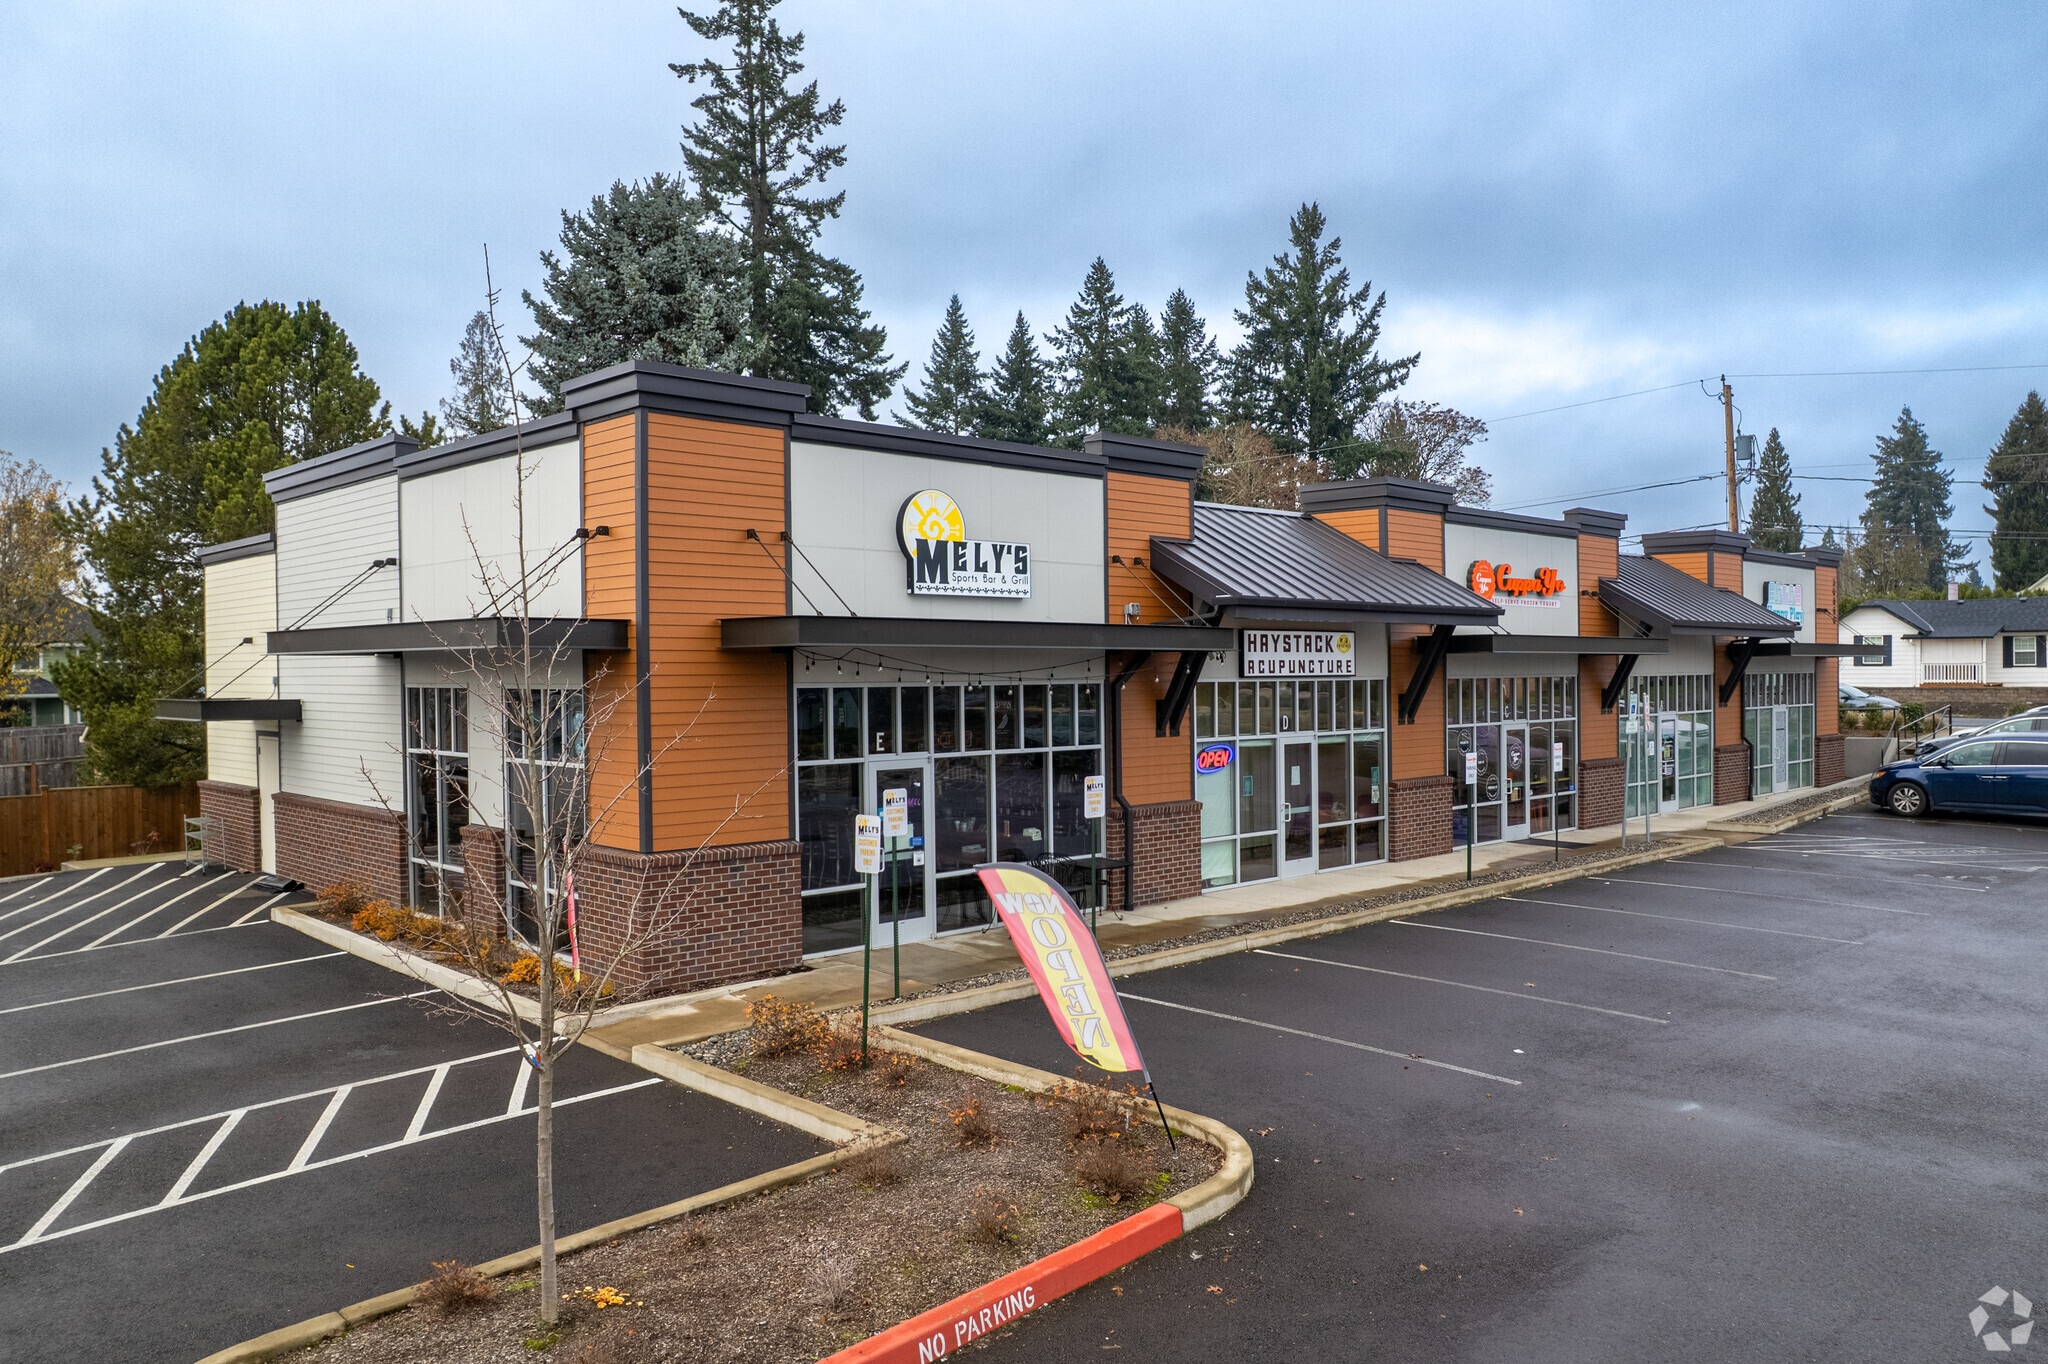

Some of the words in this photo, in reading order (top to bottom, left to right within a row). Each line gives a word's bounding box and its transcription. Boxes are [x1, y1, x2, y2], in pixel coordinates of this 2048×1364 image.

[952, 572, 978, 584] Sports
[983, 573, 997, 584] Bar
[1001, 575, 1007, 584] &
[1011, 575, 1029, 585] Grill
[1247, 633, 1334, 653] HAYSTACK
[1248, 659, 1352, 674] ACUPUNCTURE
[1282, 715, 1289, 730] D
[876, 732, 885, 751] E
[1199, 750, 1229, 768] OPEN
[918, 1332, 946, 1364] NO
[955, 1286, 1036, 1348] PARKING
